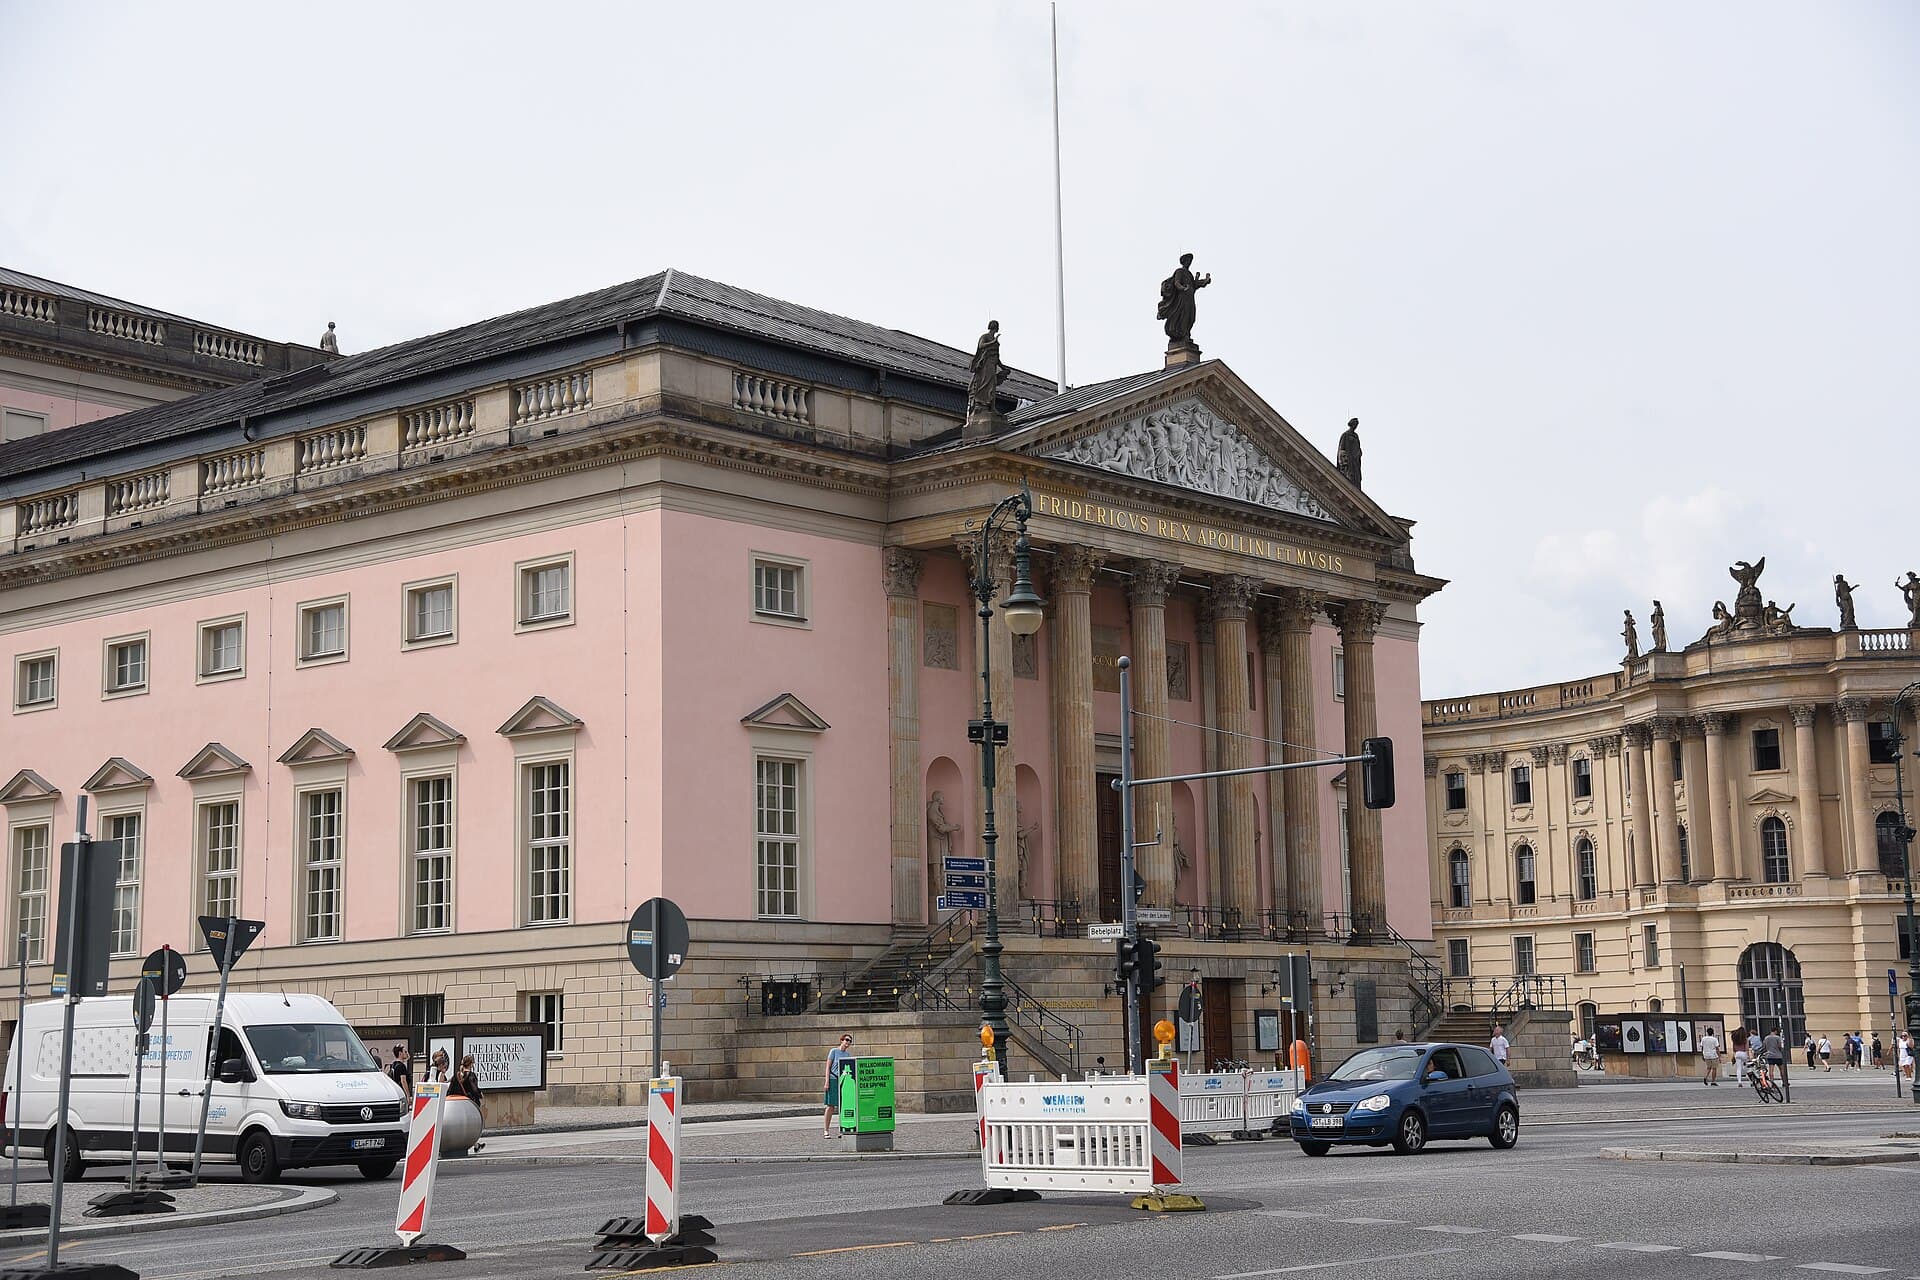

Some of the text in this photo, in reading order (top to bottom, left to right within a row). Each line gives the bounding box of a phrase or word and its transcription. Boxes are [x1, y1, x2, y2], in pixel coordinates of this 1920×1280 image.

[1039, 494, 1343, 572] FRIDERICVS REX APOLLINI ET MVSIS
[1090, 927, 1122, 936] Bebelplatz
[469, 1043, 525, 1053] DIE LUSTIGEN
[473, 1063, 509, 1072] INDSOR
